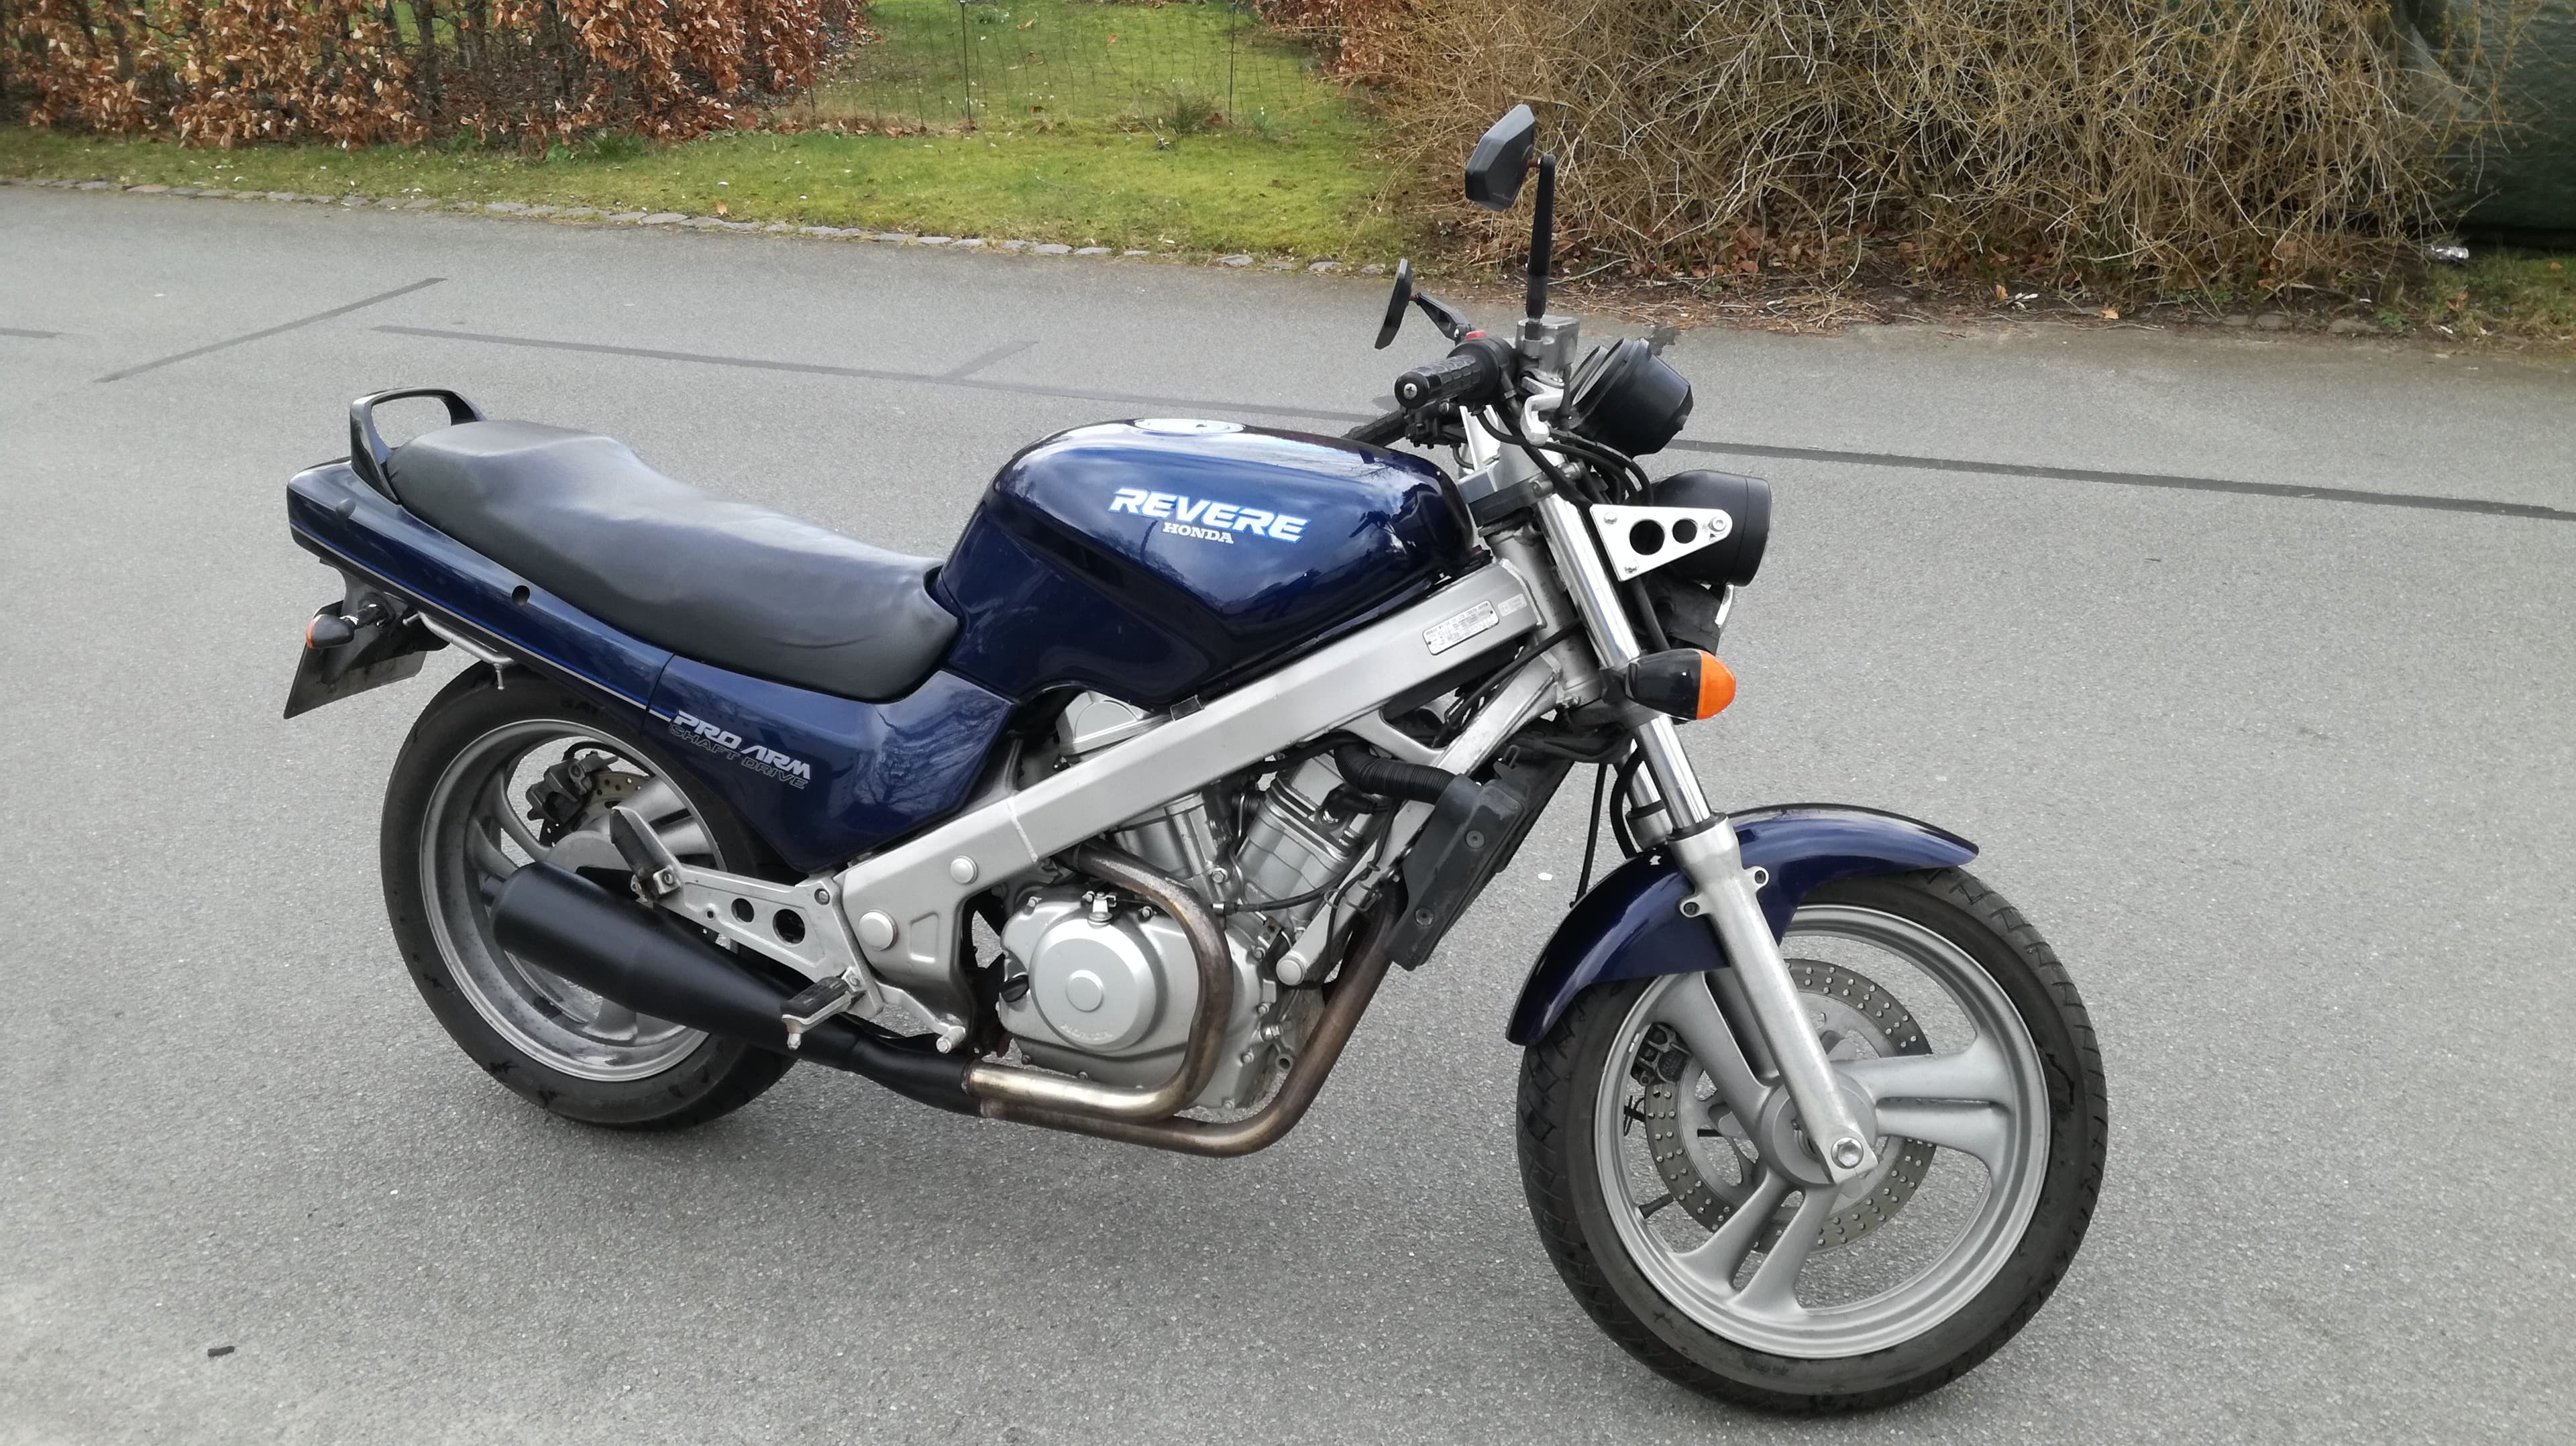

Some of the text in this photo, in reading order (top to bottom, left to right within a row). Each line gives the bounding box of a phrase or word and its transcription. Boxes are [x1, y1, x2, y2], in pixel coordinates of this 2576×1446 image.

[1108, 488, 1311, 543] REVERE
[1163, 522, 1234, 544] HONDA
[670, 724, 808, 789] SHAFT DRIVE
[674, 710, 810, 779] PRO ARM
